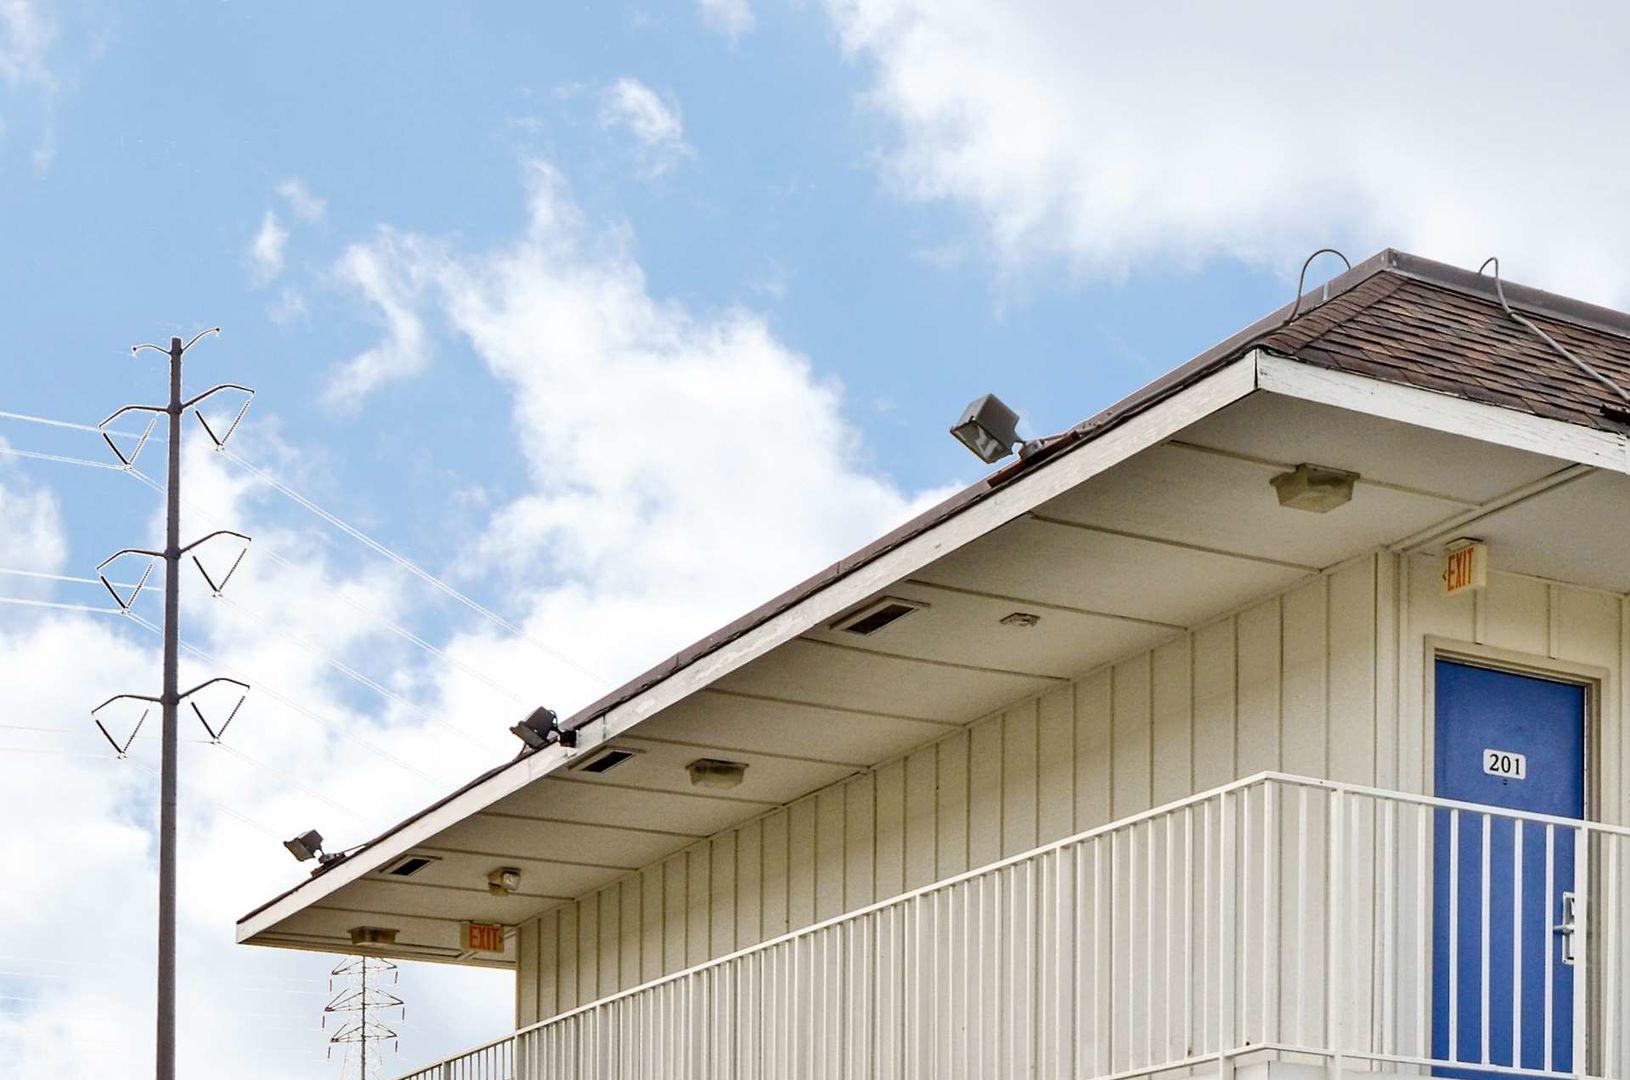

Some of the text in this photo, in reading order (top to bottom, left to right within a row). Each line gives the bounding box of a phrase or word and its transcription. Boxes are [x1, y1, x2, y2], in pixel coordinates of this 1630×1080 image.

[1447, 547, 1474, 591] EXIT
[1489, 753, 1519, 775] 201
[469, 925, 499, 951] EXIT
